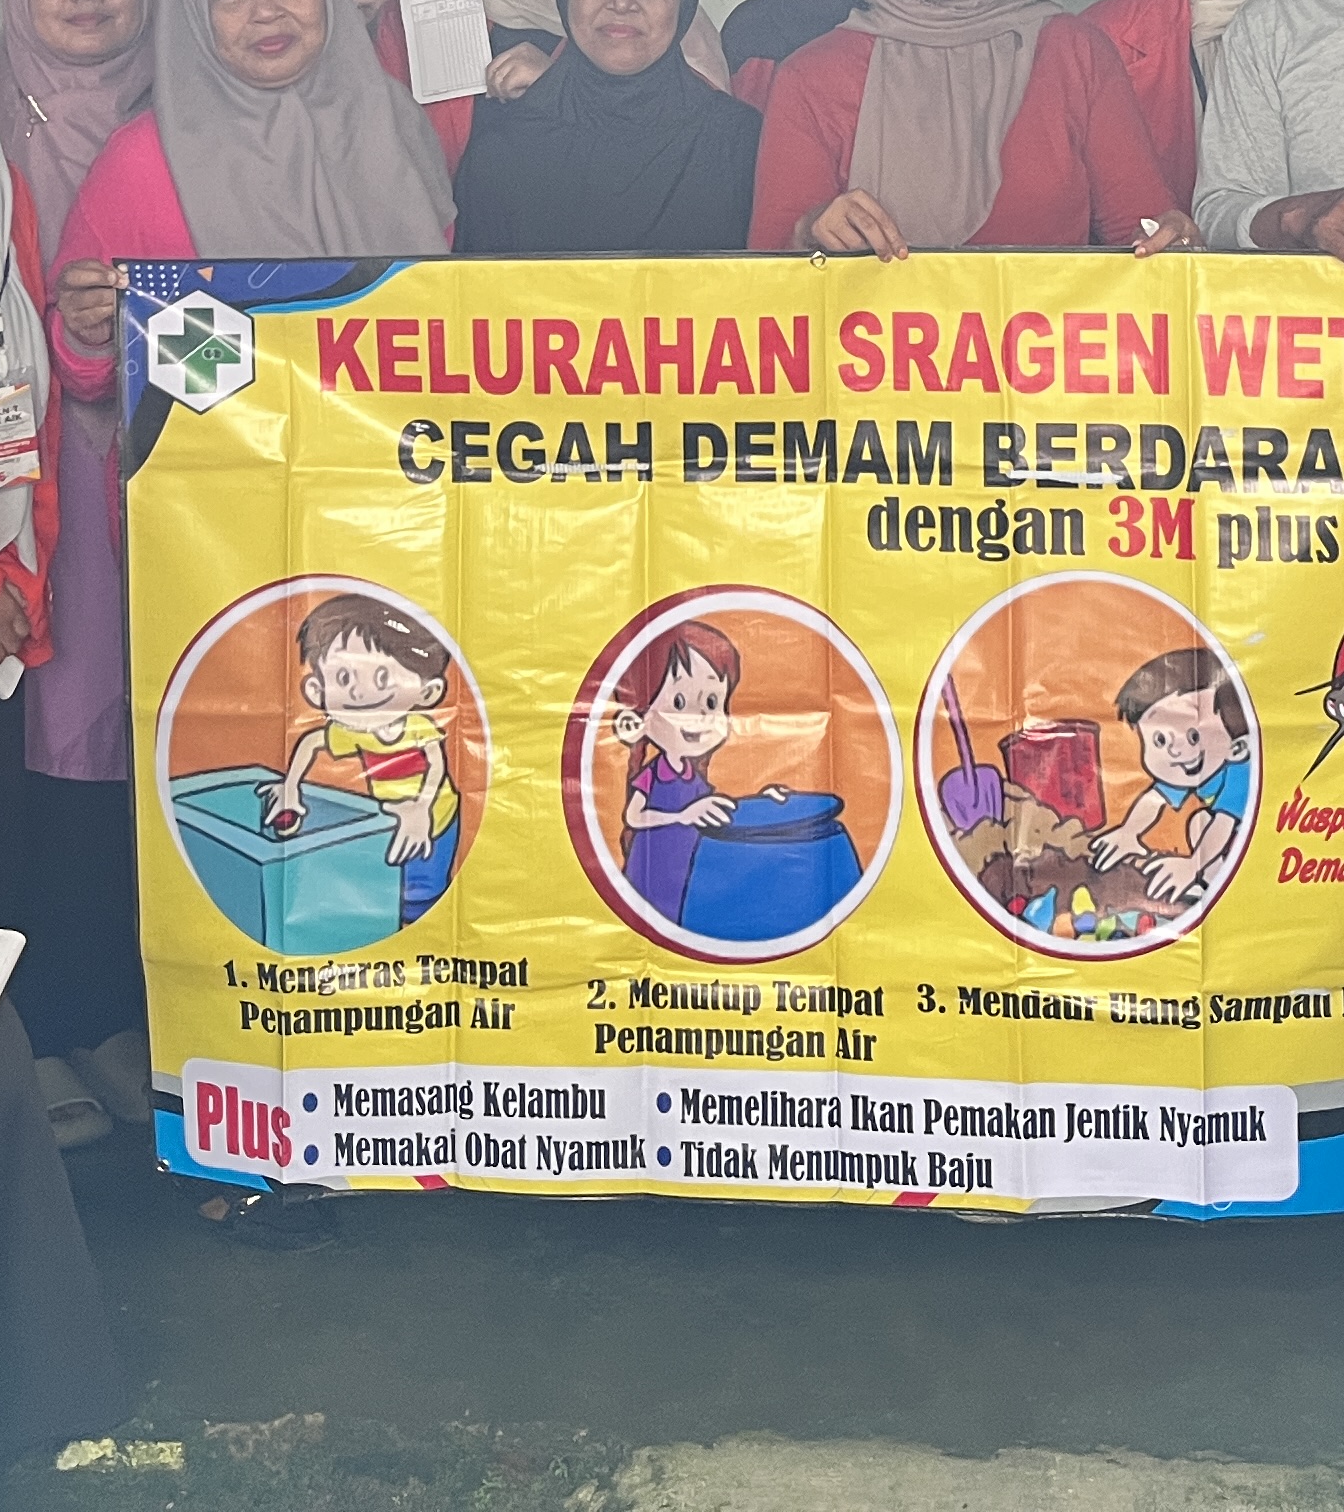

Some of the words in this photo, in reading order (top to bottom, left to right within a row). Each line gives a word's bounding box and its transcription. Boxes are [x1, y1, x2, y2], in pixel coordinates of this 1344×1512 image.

[316, 315, 811, 396] KELURAHAN
[837, 311, 1170, 396] SRAGEN
[397, 418, 653, 484] CEGAH
[683, 420, 953, 485] DEMAM
[866, 496, 1085, 563] dengan
[1107, 495, 1197, 561] 3M
[1217, 506, 1342, 569] plus
[223, 961, 248, 988] 1.
[257, 958, 406, 996] Menguras
[415, 955, 529, 990] Tempat
[586, 979, 617, 1011] 2.
[627, 978, 761, 1015] Menutup
[772, 981, 885, 1018] Tempat
[239, 1000, 462, 1036] Penampungan
[469, 998, 516, 1031] Air
[916, 983, 946, 1014] 3.
[957, 986, 1096, 1022] Mendaur
[1109, 991, 1202, 1030] Ulang
[595, 1023, 826, 1061] Penampungan
[834, 1027, 877, 1063] Air
[196, 1081, 293, 1168] Plus
[333, 1082, 473, 1120] Memasang
[483, 1082, 607, 1119] Kelambu
[679, 1087, 843, 1130] Memelihara
[850, 1094, 915, 1134] Ikan
[923, 1100, 1057, 1141] Pemakan
[1064, 1102, 1150, 1143] Jentik
[1158, 1106, 1267, 1148] Nyamuk
[333, 1128, 457, 1167] Memakai
[465, 1131, 528, 1169] Obat
[535, 1134, 647, 1173] Nyamuk
[679, 1142, 759, 1179] Tidak
[767, 1145, 918, 1191] Menumpuk
[928, 1151, 993, 1191] Baju
